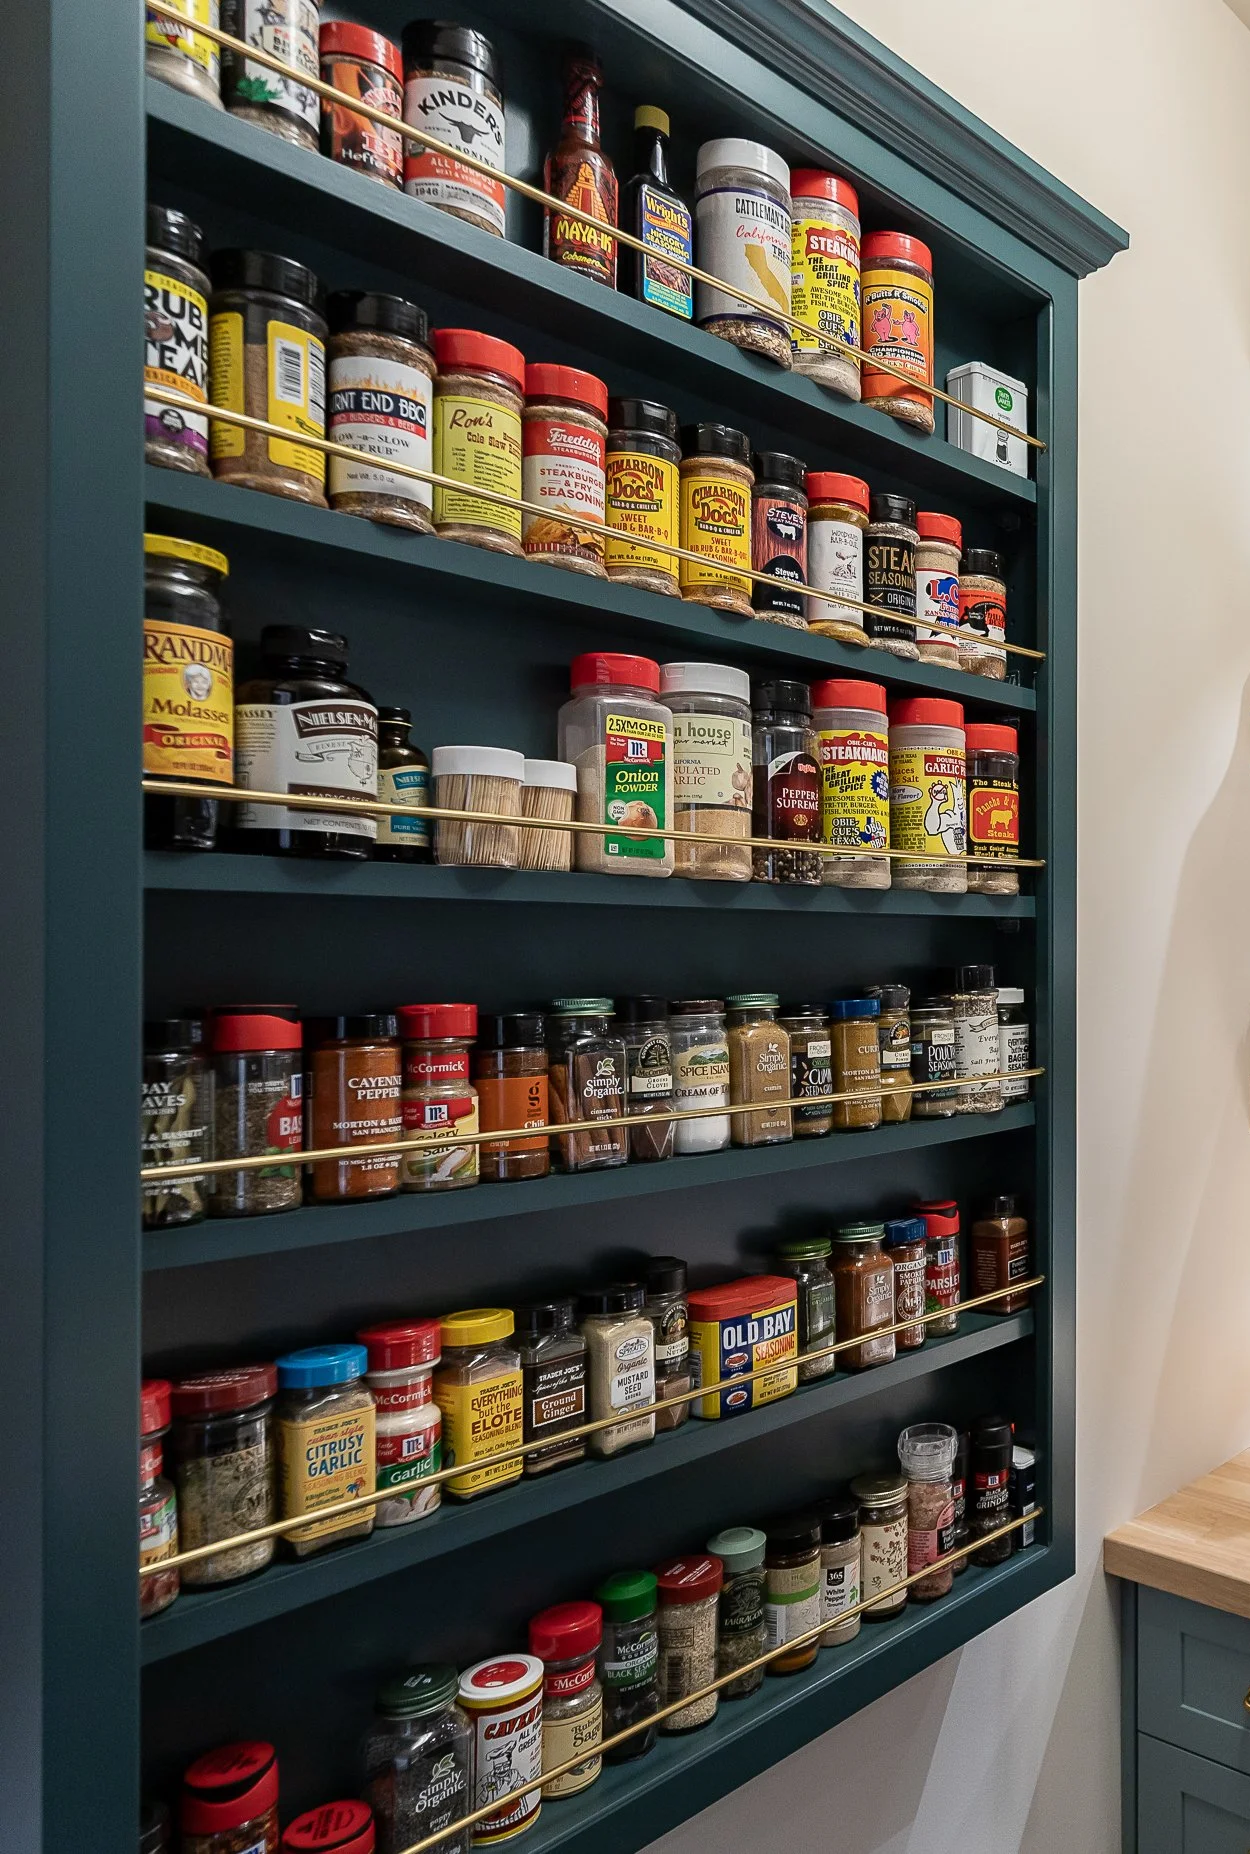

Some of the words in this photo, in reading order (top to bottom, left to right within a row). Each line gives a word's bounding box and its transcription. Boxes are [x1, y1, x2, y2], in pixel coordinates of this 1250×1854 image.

[418, 90, 503, 146] KINDER'S
[431, 157, 450, 169] ALL
[645, 194, 688, 229] Wright's
[735, 198, 784, 230] CATTLEMAN'S
[557, 219, 613, 254] MAYA-IK
[651, 229, 685, 249] HICKORY
[736, 225, 787, 250] California
[645, 234, 690, 258] SEASONING
[562, 251, 602, 268] Cobanero
[808, 257, 824, 265] THE
[812, 264, 838, 273] GREAT
[816, 271, 851, 284] GRILLING
[827, 280, 849, 290] SPICE
[810, 287, 844, 299] AWESOME
[872, 290, 893, 304] Butts
[811, 299, 828, 308] FISH,
[818, 310, 845, 323] OBIE-
[817, 318, 845, 333] CUE'S
[361, 392, 395, 413] END
[398, 398, 427, 426] BBQ
[450, 409, 493, 430] Ron's
[378, 434, 409, 448] SLOW
[466, 432, 484, 444] Cole
[488, 436, 506, 450] Slaw
[547, 427, 602, 462] Freddy's
[606, 460, 664, 491] CIMARRON
[564, 479, 572, 488] &
[574, 481, 592, 494] FRY
[612, 477, 655, 501] DOCS
[539, 486, 606, 512] SEASONING
[611, 500, 629, 509] BAR-B-Q
[691, 485, 746, 519] CIMARRON
[620, 512, 648, 524] SWEET
[701, 506, 738, 526] DOCS
[767, 508, 804, 525] STEVE'S
[769, 517, 783, 525] MEAT
[784, 520, 804, 531] MARKET
[711, 537, 731, 547] SWEET
[700, 546, 713, 554] RUB
[868, 546, 916, 574] STEAK
[775, 567, 799, 579] Steve's
[151, 696, 230, 724] Molasses
[608, 717, 627, 734] 2.5X
[626, 720, 664, 735] MORE
[687, 722, 733, 743] house
[161, 733, 226, 748] ORIGINAL
[623, 756, 652, 765] McCormick
[616, 769, 659, 784] Onion
[825, 769, 852, 782] GREAT
[925, 763, 958, 778] GARLIC
[828, 774, 867, 789] GRILLING
[903, 775, 920, 785] Salt
[972, 780, 987, 788] The
[992, 781, 1012, 789] Steak
[615, 784, 659, 794] POWDER
[839, 783, 864, 795] SPICE
[776, 797, 820, 812] SUPREME
[850, 802, 879, 811] BURGERS,
[857, 795, 876, 803] STEAK
[975, 797, 1000, 816] Pancho
[1003, 794, 1010, 803] &
[613, 809, 626, 817] GMO
[843, 809, 880, 818] MUSHROOMS
[303, 817, 320, 829] NET
[393, 824, 411, 832] PURE
[832, 817, 860, 829] OBIE-
[832, 826, 860, 838] CUE'S
[987, 830, 1015, 839] Steaks
[830, 836, 862, 848] TEXAS
[759, 1053, 785, 1067] Simply
[407, 1061, 465, 1076] McCormick
[680, 1065, 708, 1079] SPICE
[757, 1062, 788, 1077] Organic
[842, 1069, 869, 1077] MORTON
[586, 1074, 621, 1091] Simply
[764, 1083, 783, 1092] cumin
[357, 1087, 400, 1100] PEPPER
[583, 1085, 625, 1100] Organic.
[675, 1087, 708, 1099] CREAM
[709, 1087, 720, 1096] OF
[805, 1085, 820, 1098] SEED
[590, 1106, 618, 1116] cinnamon
[333, 1119, 379, 1131] MORTON
[379, 1119, 387, 1130] &
[420, 1120, 453, 1131] McCormick
[524, 1118, 545, 1129] Chili
[361, 1164, 372, 1172] 1.8
[373, 1163, 384, 1171] OZ
[722, 1321, 759, 1351] OLD
[763, 1308, 792, 1342] BAY
[755, 1333, 795, 1362] SEASONING
[539, 1370, 563, 1382] TRADER
[563, 1363, 583, 1376] JOE'S
[617, 1356, 648, 1374] Organic
[617, 1370, 649, 1389] MUSTARD
[479, 1384, 500, 1396] TRADER
[501, 1379, 517, 1392] JOE'S
[624, 1383, 642, 1396] SEED
[375, 1386, 432, 1406] McCormick
[471, 1384, 523, 1412] EVERYTHING
[541, 1393, 576, 1411] Ground
[624, 1391, 642, 1402] GROUND
[478, 1406, 495, 1420] but
[496, 1402, 512, 1415] the
[543, 1404, 575, 1421] Ginger
[313, 1423, 339, 1435] TRADER
[340, 1417, 360, 1429] JOE'S
[471, 1407, 523, 1435] ELOTE
[306, 1431, 339, 1445] cuban
[340, 1423, 364, 1439] style
[471, 1428, 504, 1444] SEASONING
[504, 1423, 523, 1436] BLEND
[305, 1433, 364, 1463] CITRUSY
[308, 1448, 363, 1479] GARLIC
[390, 1458, 431, 1484] Garlic
[975, 1495, 1009, 1512] GRINDER
[828, 1572, 844, 1582] 365
[824, 1594, 846, 1604] Pepper
[825, 1588, 845, 1597] White
[826, 1601, 844, 1609] Ground
[724, 1609, 764, 1628] TARRAGON
[607, 1669, 632, 1682] BLACK
[518, 1730, 531, 1743] ALL
[518, 1735, 537, 1753] GREEK
[572, 1722, 602, 1751] Sage
[429, 1811, 452, 1829] poppy
